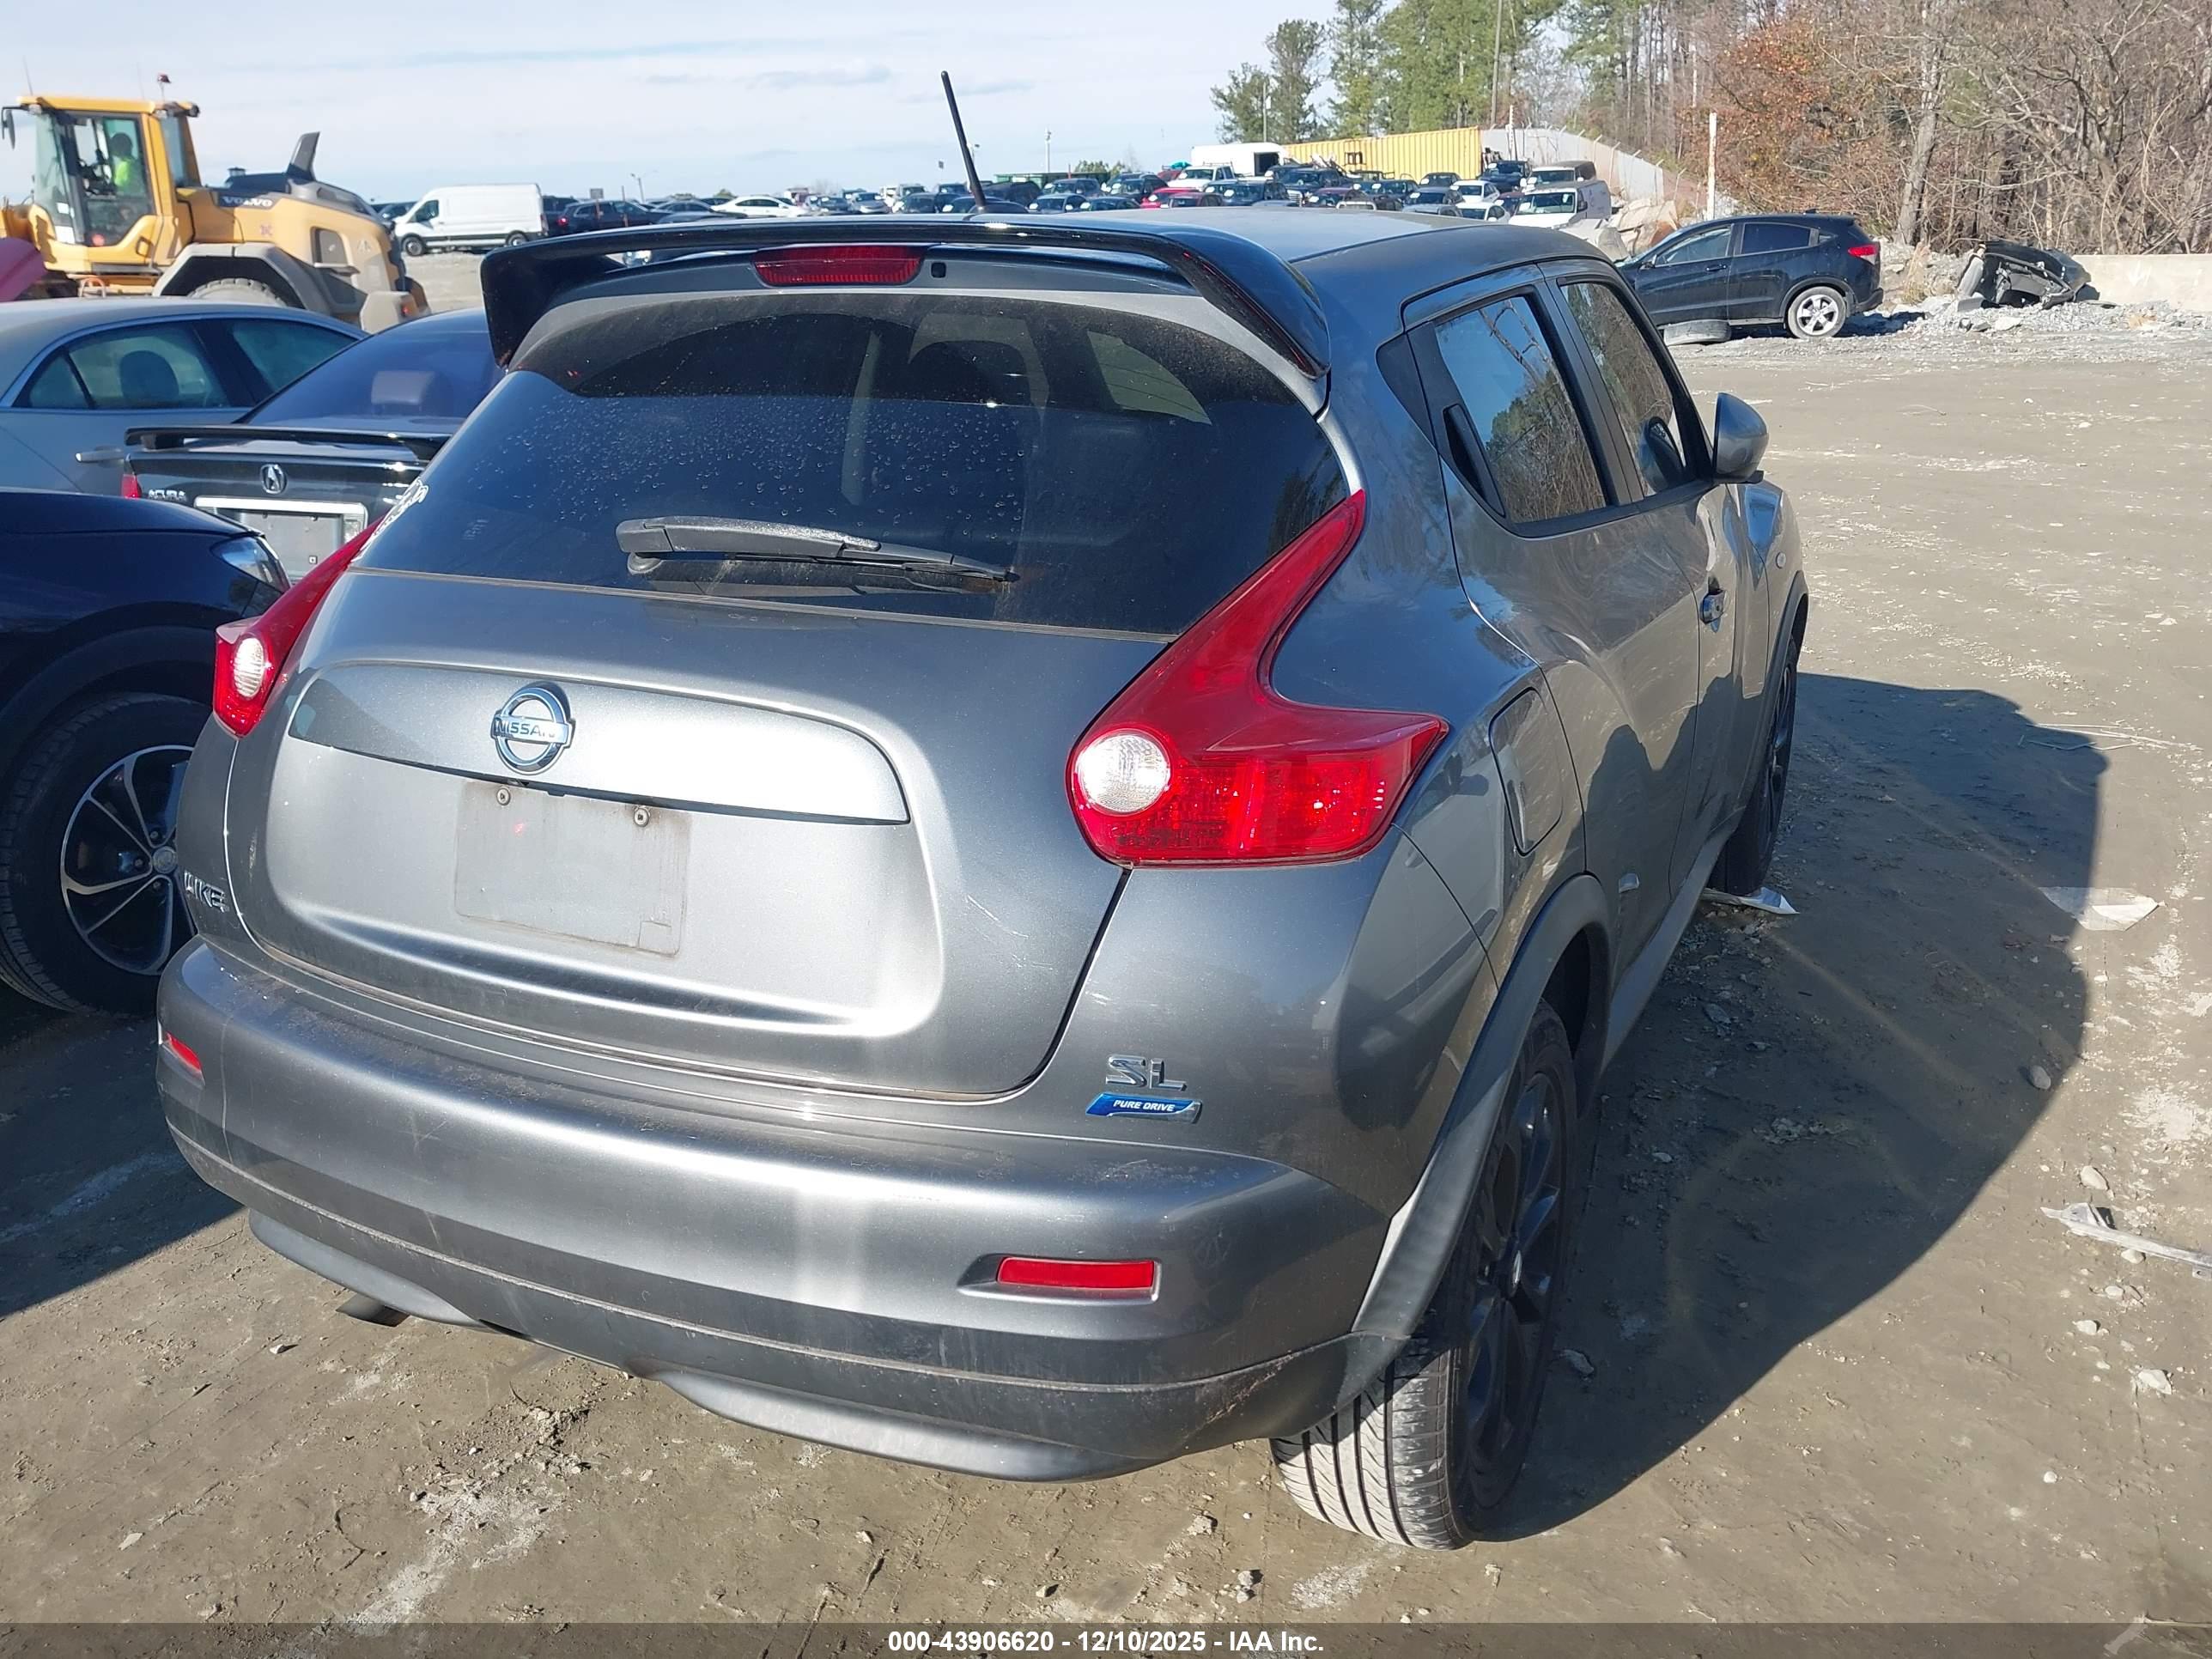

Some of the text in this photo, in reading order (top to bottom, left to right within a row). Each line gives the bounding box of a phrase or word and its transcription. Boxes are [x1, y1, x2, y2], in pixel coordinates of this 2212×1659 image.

[1105, 1054, 1187, 1092] SL
[1113, 1099, 1176, 1112] PURE DRIVE
